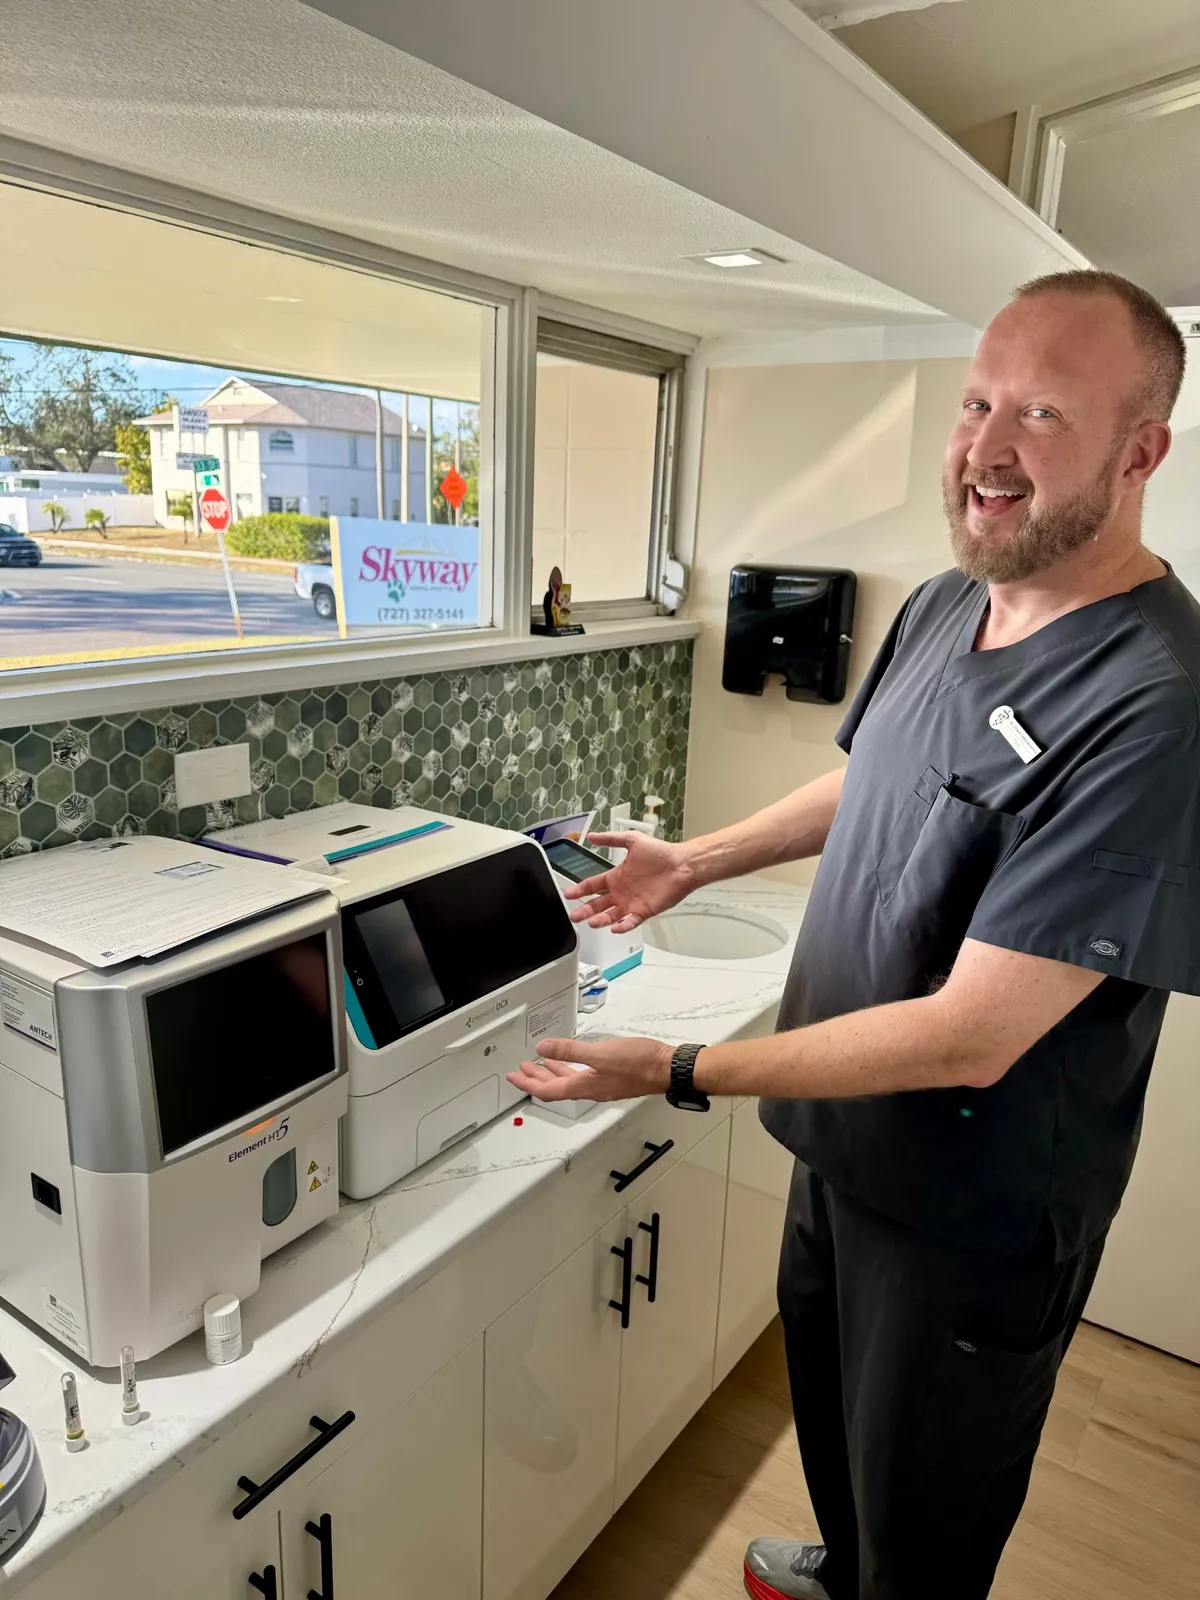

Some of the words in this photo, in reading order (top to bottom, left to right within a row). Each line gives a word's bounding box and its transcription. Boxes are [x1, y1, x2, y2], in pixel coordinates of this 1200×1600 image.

[202, 501, 227, 519] STOP
[359, 545, 478, 592] Skyway
[378, 607, 410, 622] (727)
[413, 608, 464, 620] 327-5141
[495, 998, 509, 1011] DCX
[29, 1024, 53, 1041] ANTECH
[228, 1136, 267, 1163] Element
